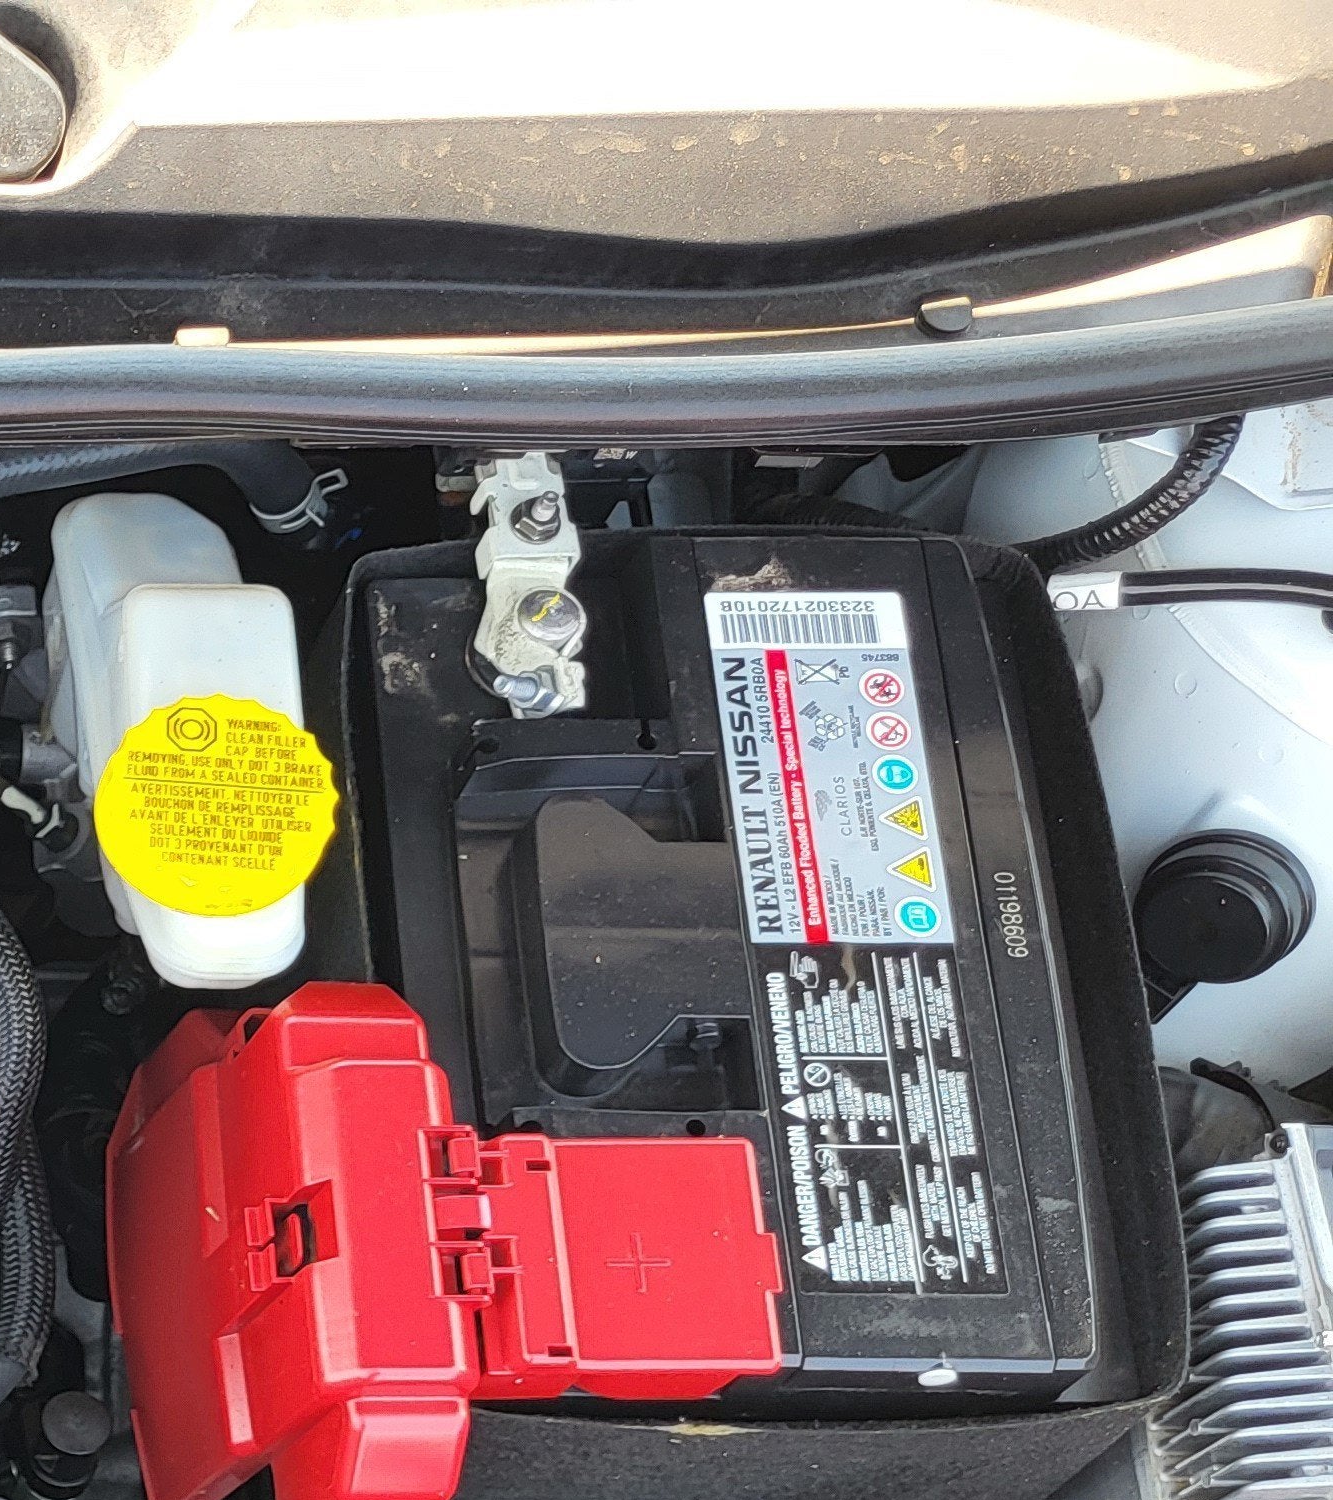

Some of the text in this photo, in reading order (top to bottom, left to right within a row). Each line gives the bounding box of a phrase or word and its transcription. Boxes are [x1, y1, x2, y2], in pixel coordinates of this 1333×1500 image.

[840, 667, 849, 678] Pb
[226, 719, 281, 732] WARNING:
[756, 706, 774, 743] 24410
[226, 732, 306, 748] CLEAN FILLER
[226, 746, 297, 760] CAP BEFORE
[127, 764, 158, 776] FLUID
[164, 766, 196, 779] FROM
[200, 769, 207, 780] A
[212, 771, 257, 784] SEALED
[192, 756, 212, 768] USE
[215, 757, 244, 770] ONLY
[249, 760, 268, 771] DOT
[285, 763, 323, 776] BRAKE
[145, 796, 296, 818] BOUCHON DE REMPLISSAGE
[234, 790, 292, 805] NETTOYER
[296, 794, 310, 806] LE
[721, 657, 783, 935] RENAULT NISSAN
[773, 669, 822, 925] Enhanced Flooded Battery Special technology
[833, 776, 852, 836] CLARIOS
[130, 809, 170, 821] AVANT
[174, 812, 187, 824] DE
[261, 819, 312, 833] UTILISER
[150, 823, 283, 844] SEULEMENT DU LIQUIDE
[150, 836, 170, 848] DOT
[186, 839, 253, 854] PROVENANT
[767, 772, 801, 933] 12V L2 EFB 60Ah 510A (EN)
[162, 851, 228, 867] CONTENANT
[858, 899, 869, 936] FOR POUR
[993, 872, 1029, 958] 01198609
[766, 972, 800, 1095] PELIGRO/VENENO
[787, 1125, 821, 1246] DANGER/POISON
